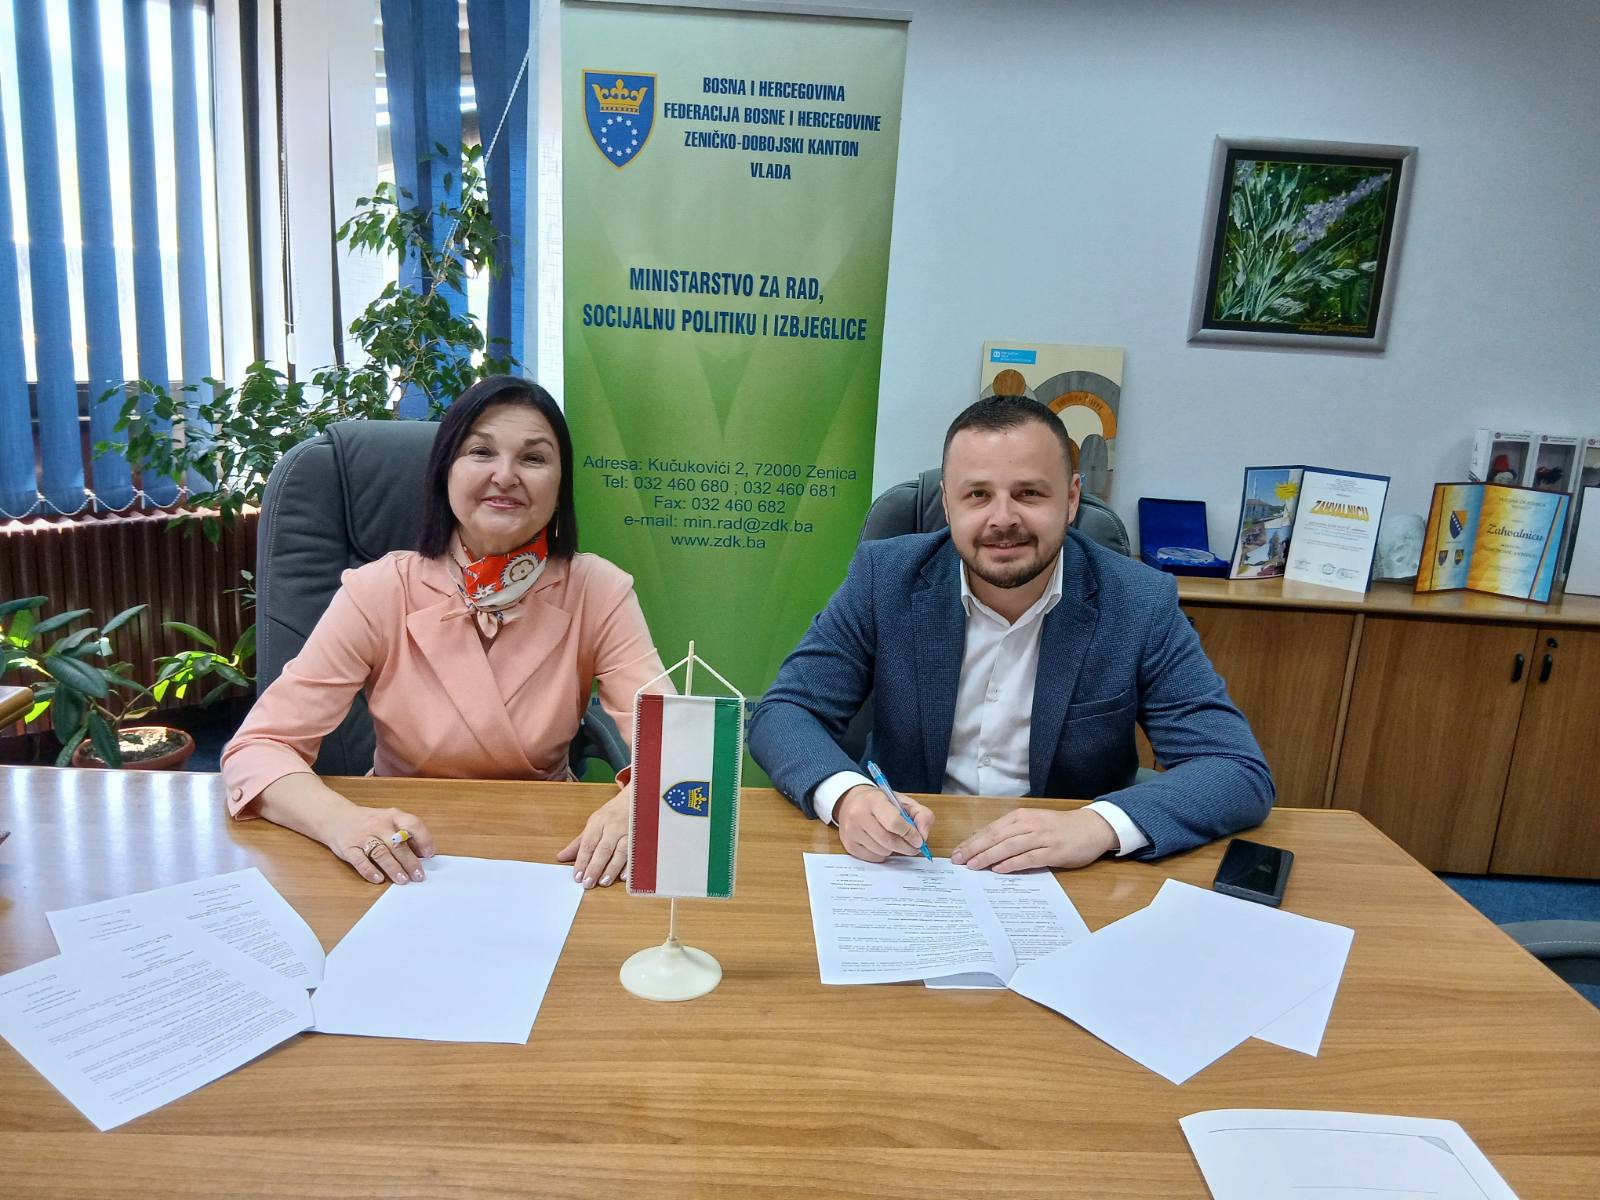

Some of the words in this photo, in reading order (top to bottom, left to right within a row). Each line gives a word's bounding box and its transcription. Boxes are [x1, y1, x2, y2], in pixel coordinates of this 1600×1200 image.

[703, 77, 746, 95] BOSNA
[750, 80, 755, 96] I
[759, 80, 845, 101] HERCEGOVINA
[663, 102, 740, 122] FEDERACIJA
[744, 107, 785, 125] BOSNE
[789, 110, 794, 126] I
[797, 110, 881, 131] HERCEGOVINE
[684, 129, 804, 154] ZENIČKO-DOBOJSKI
[808, 138, 859, 156] KANTON
[750, 162, 791, 180] VLADA
[630, 267, 754, 297] MINISTARSTVO
[759, 274, 780, 298] ZA
[785, 276, 824, 304] RAD,
[582, 303, 676, 331] SOCIJALNU
[681, 309, 757, 336] POLITIKU
[763, 314, 768, 336] I
[773, 314, 867, 341] IZBJEGLICE
[583, 456, 643, 471] Adresa:
[648, 458, 730, 474] Kučukovići
[735, 462, 749, 477] 2,
[754, 462, 801, 477] 72000
[806, 465, 857, 480] Zenica
[602, 474, 628, 489] Tel:
[634, 476, 662, 490] 032
[667, 477, 696, 492] 460
[700, 479, 729, 493] 680
[743, 480, 771, 494] 032
[776, 482, 805, 496] 460
[809, 484, 837, 497] 681
[654, 495, 687, 510] Fax:
[691, 497, 720, 511] 032
[724, 499, 753, 512] 460
[758, 500, 786, 514] 682
[624, 514, 678, 528] e-mail:
[683, 516, 814, 534] min.rad@zdk.ba
[671, 535, 766, 549] www.zdk.ba
